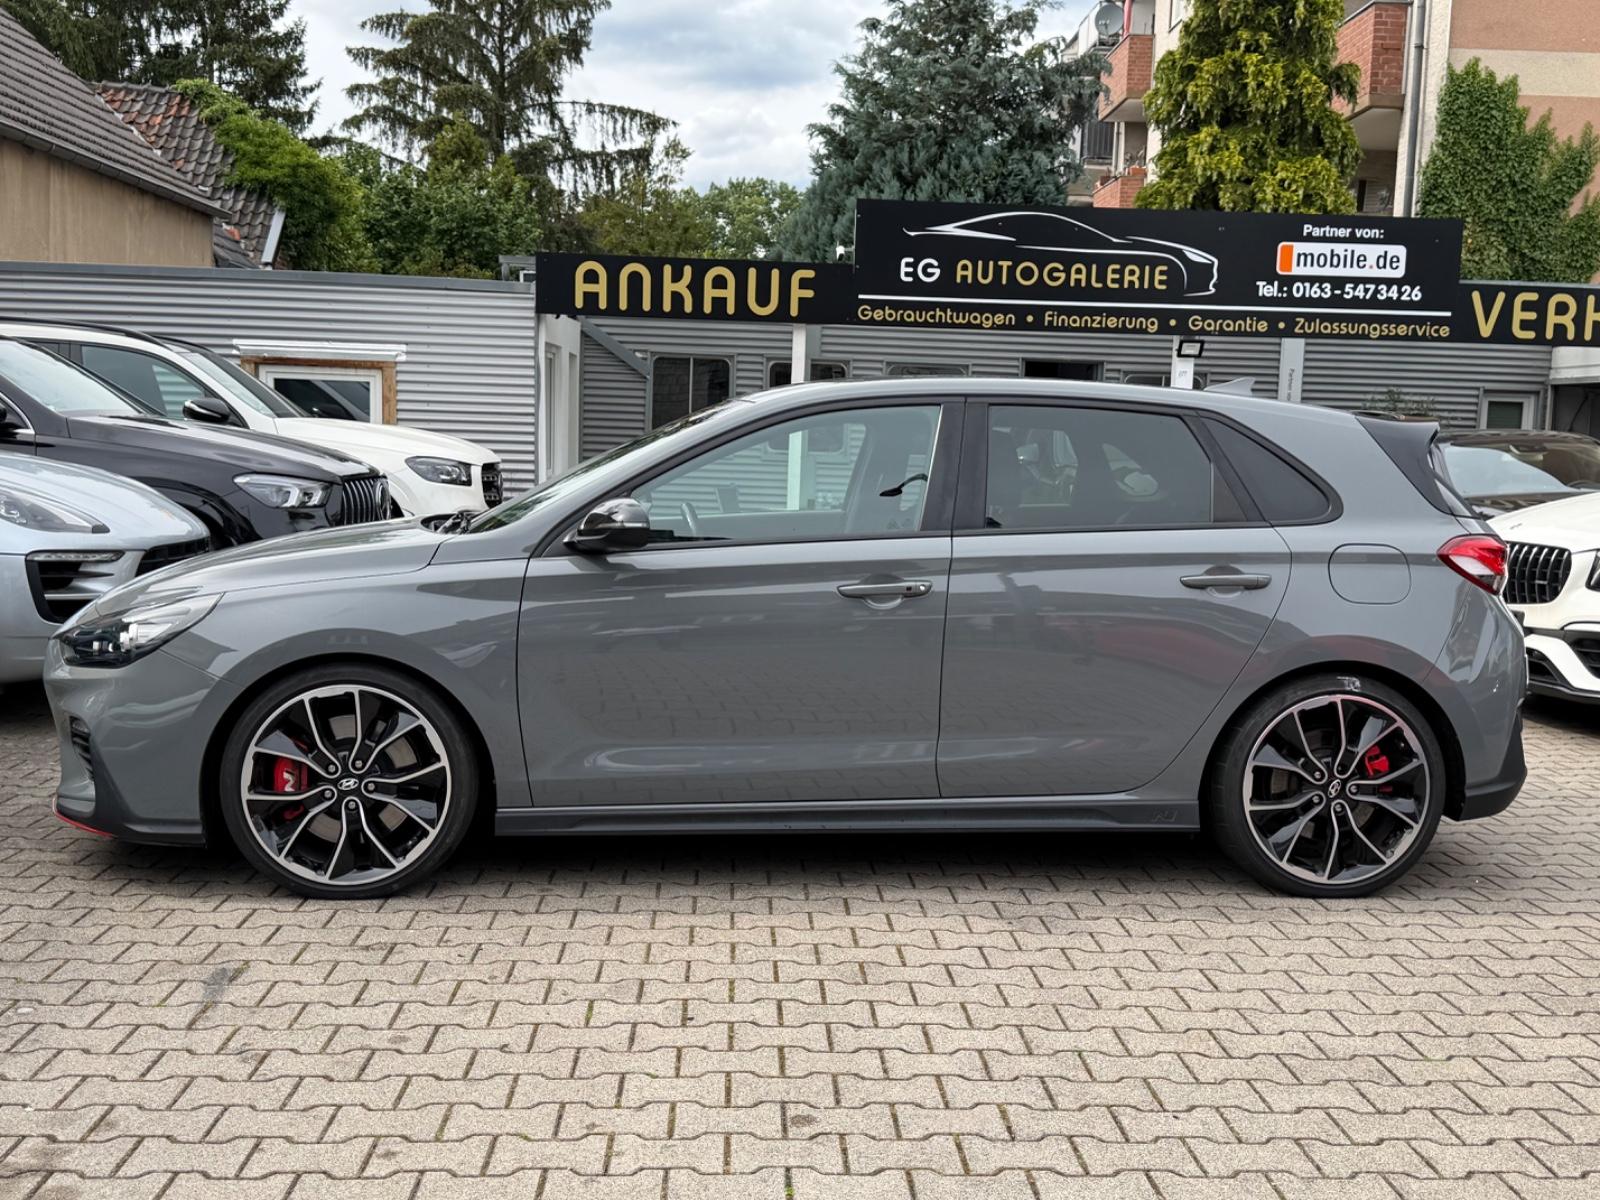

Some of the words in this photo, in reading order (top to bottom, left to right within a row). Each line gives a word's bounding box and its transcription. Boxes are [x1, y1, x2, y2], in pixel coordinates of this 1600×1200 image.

[1303, 224, 1352, 238] Partner
[1355, 228, 1385, 239] von:
[900, 257, 941, 282] EG
[955, 259, 1168, 290] AUTOGALERIE
[1296, 248, 1401, 271] mobile.de
[573, 260, 816, 317] ANKAUF
[1256, 281, 1288, 298] Tel.:
[857, 305, 1016, 328] Gebrauchtwagen
[1044, 311, 1159, 333] Finanzierung
[1188, 315, 1268, 332] Garantie
[1294, 317, 1451, 339] Zulassungsservice
